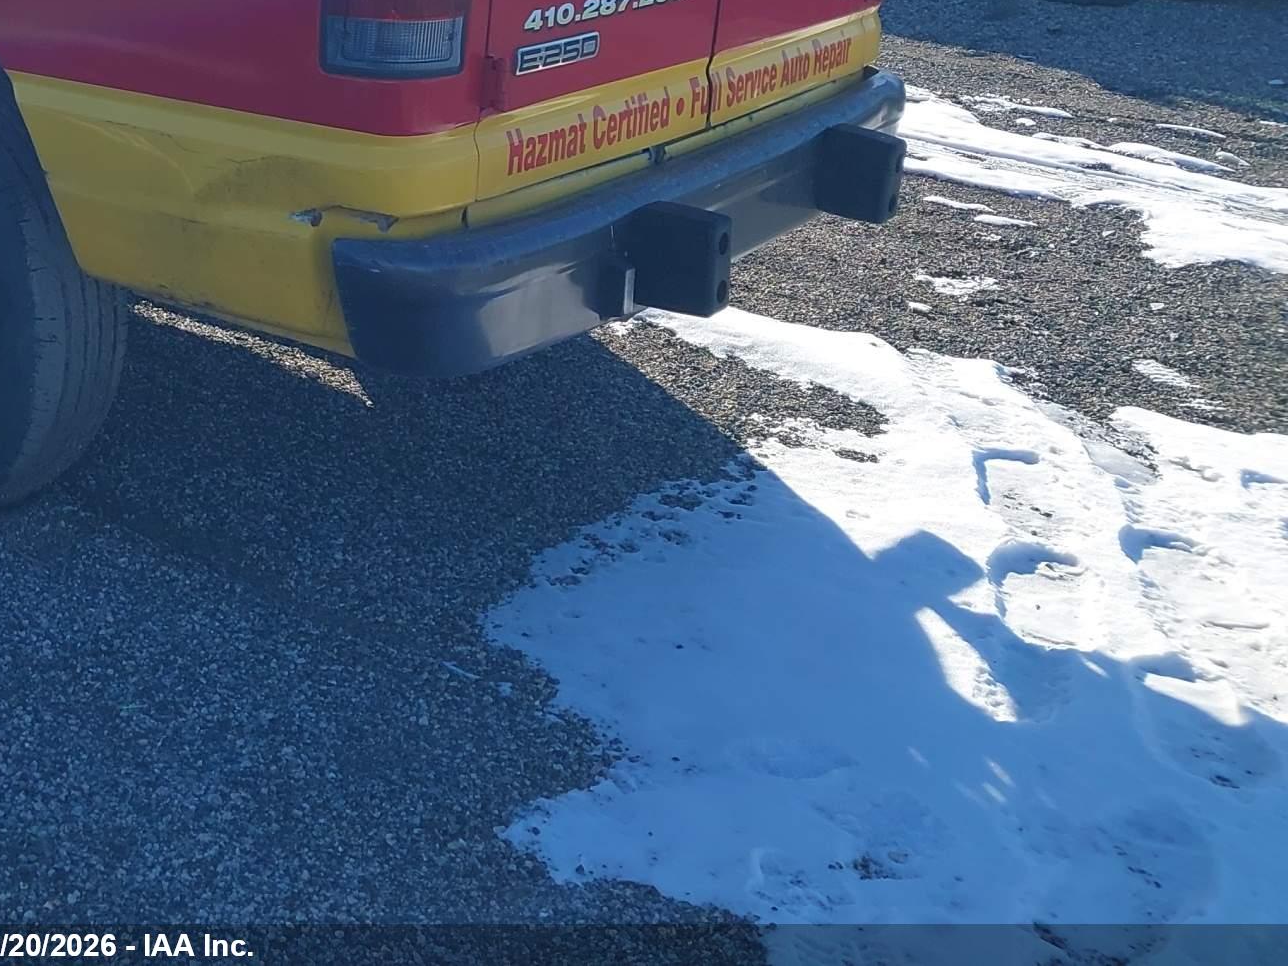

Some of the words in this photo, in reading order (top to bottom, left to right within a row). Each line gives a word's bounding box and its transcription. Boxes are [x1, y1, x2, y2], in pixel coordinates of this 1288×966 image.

[506, 110, 587, 177] Hazmat
[592, 87, 671, 151] Certified
[688, 69, 723, 120] Full
[725, 58, 778, 109] Service
[780, 49, 811, 88] Auto
[812, 35, 853, 79] Repair
